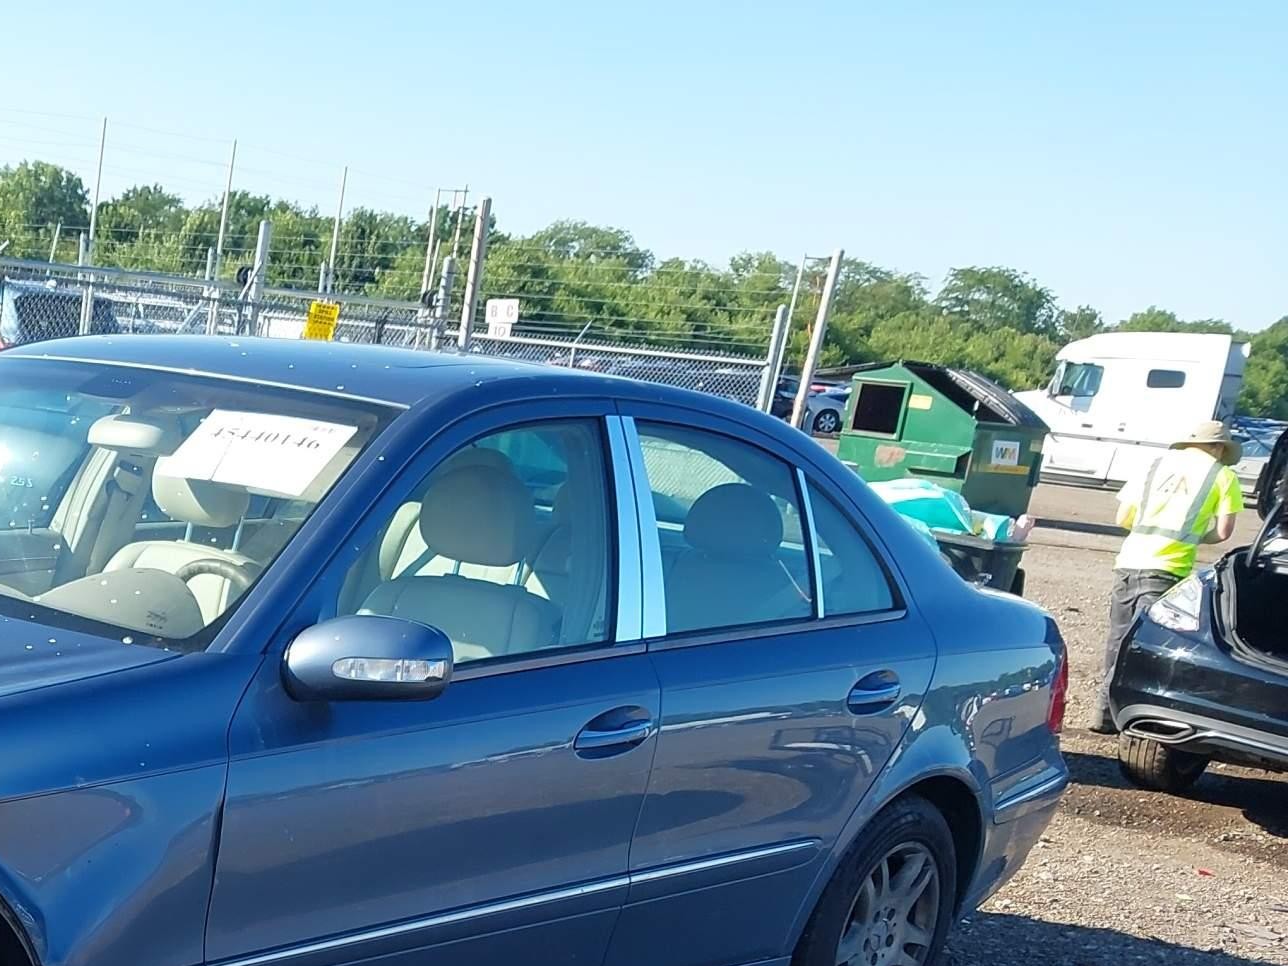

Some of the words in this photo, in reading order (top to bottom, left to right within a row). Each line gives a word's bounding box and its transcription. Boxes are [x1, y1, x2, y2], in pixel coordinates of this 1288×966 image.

[506, 304, 514, 318] C
[494, 327, 506, 337] 10
[994, 447, 1017, 461] WM
